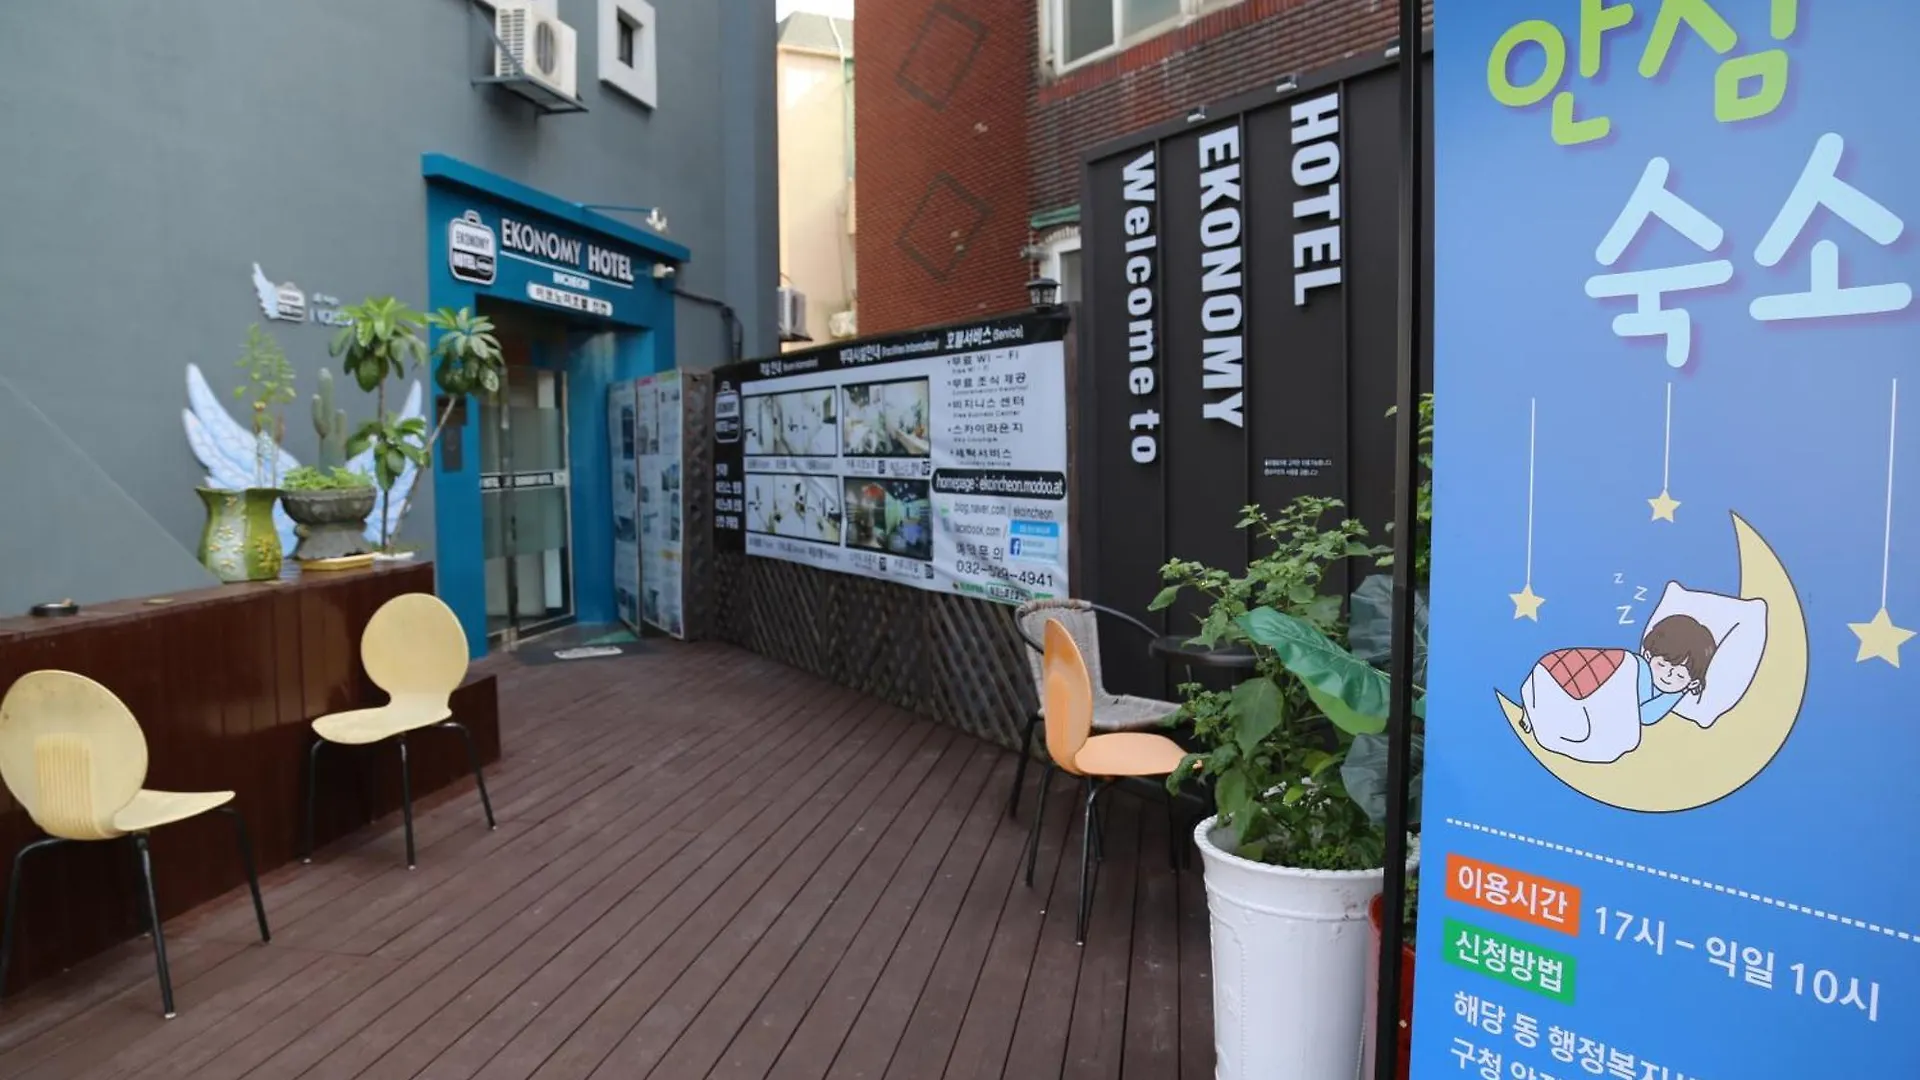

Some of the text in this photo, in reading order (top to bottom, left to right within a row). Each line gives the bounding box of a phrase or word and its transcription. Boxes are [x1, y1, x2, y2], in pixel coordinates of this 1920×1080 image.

[1487, 0, 1798, 145] 안심
[501, 217, 634, 281] EKONOMY HOTEL
[1291, 92, 1342, 306] HOTEL
[1584, 132, 1912, 368] 숙소
[1122, 150, 1160, 463] Welcome to
[1199, 125, 1244, 428] EKONOMY
[1456, 930, 1564, 993] 신청방법
[1458, 865, 1568, 923] 이용시간
[1595, 906, 1666, 956] 17시
[1705, 936, 1775, 990] 익일
[1789, 963, 1880, 1022] 10시
[1450, 1036, 1502, 1080] 구청
[1454, 990, 1506, 1036] 해당
[1513, 1012, 1540, 1049] 동
[1548, 1025, 1696, 1080] 행정복지
